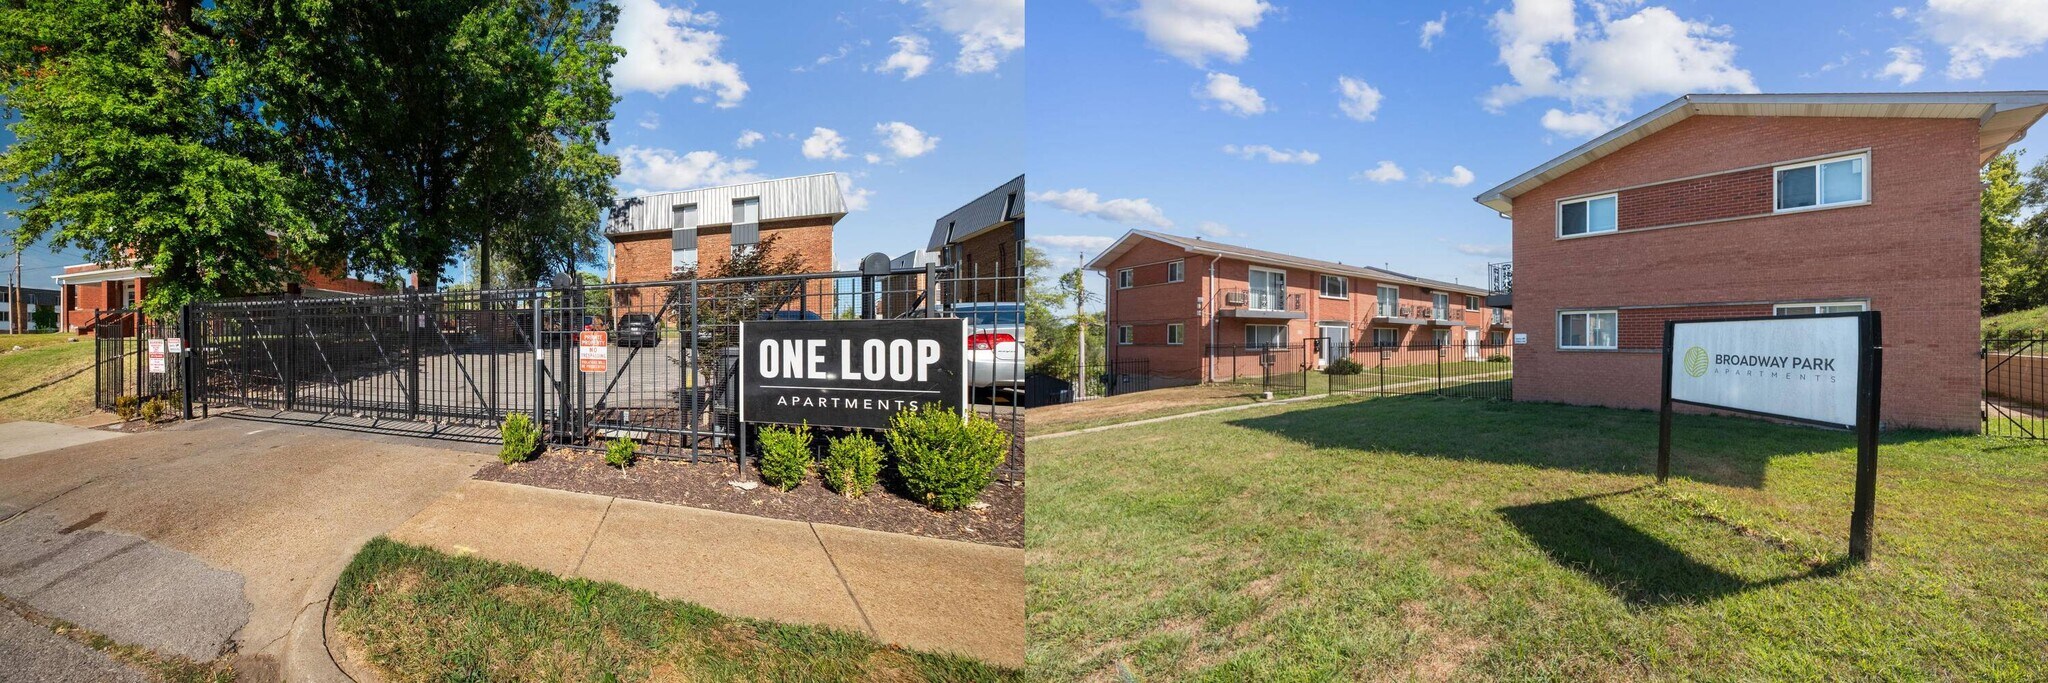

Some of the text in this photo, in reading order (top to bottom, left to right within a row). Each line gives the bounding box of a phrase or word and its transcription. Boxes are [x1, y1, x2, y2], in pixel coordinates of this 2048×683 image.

[759, 339, 941, 382] ONE LOOP
[1715, 354, 1835, 371] BROADWAY PARK
[1714, 368, 1836, 383] APARTMENTS
[777, 395, 919, 412] APARTMENTS
